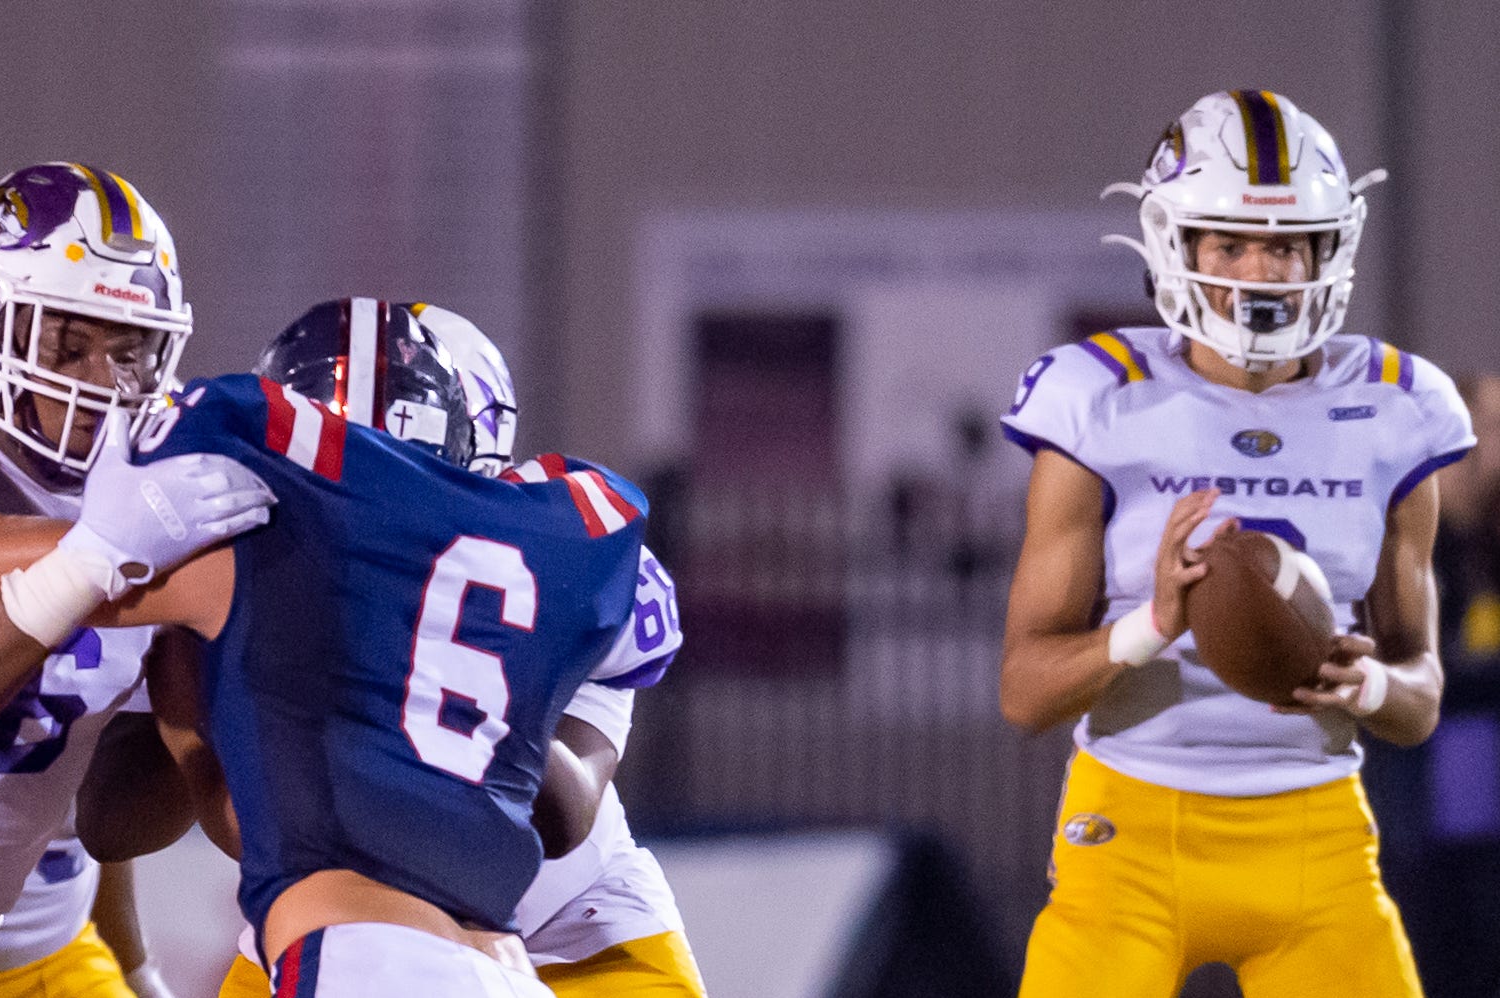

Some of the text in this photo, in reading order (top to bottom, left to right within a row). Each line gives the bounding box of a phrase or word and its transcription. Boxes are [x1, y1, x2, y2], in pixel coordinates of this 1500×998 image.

[1009, 355, 1055, 416] 9
[1150, 476, 1363, 498] WESTGATE
[400, 534, 539, 785] 6
